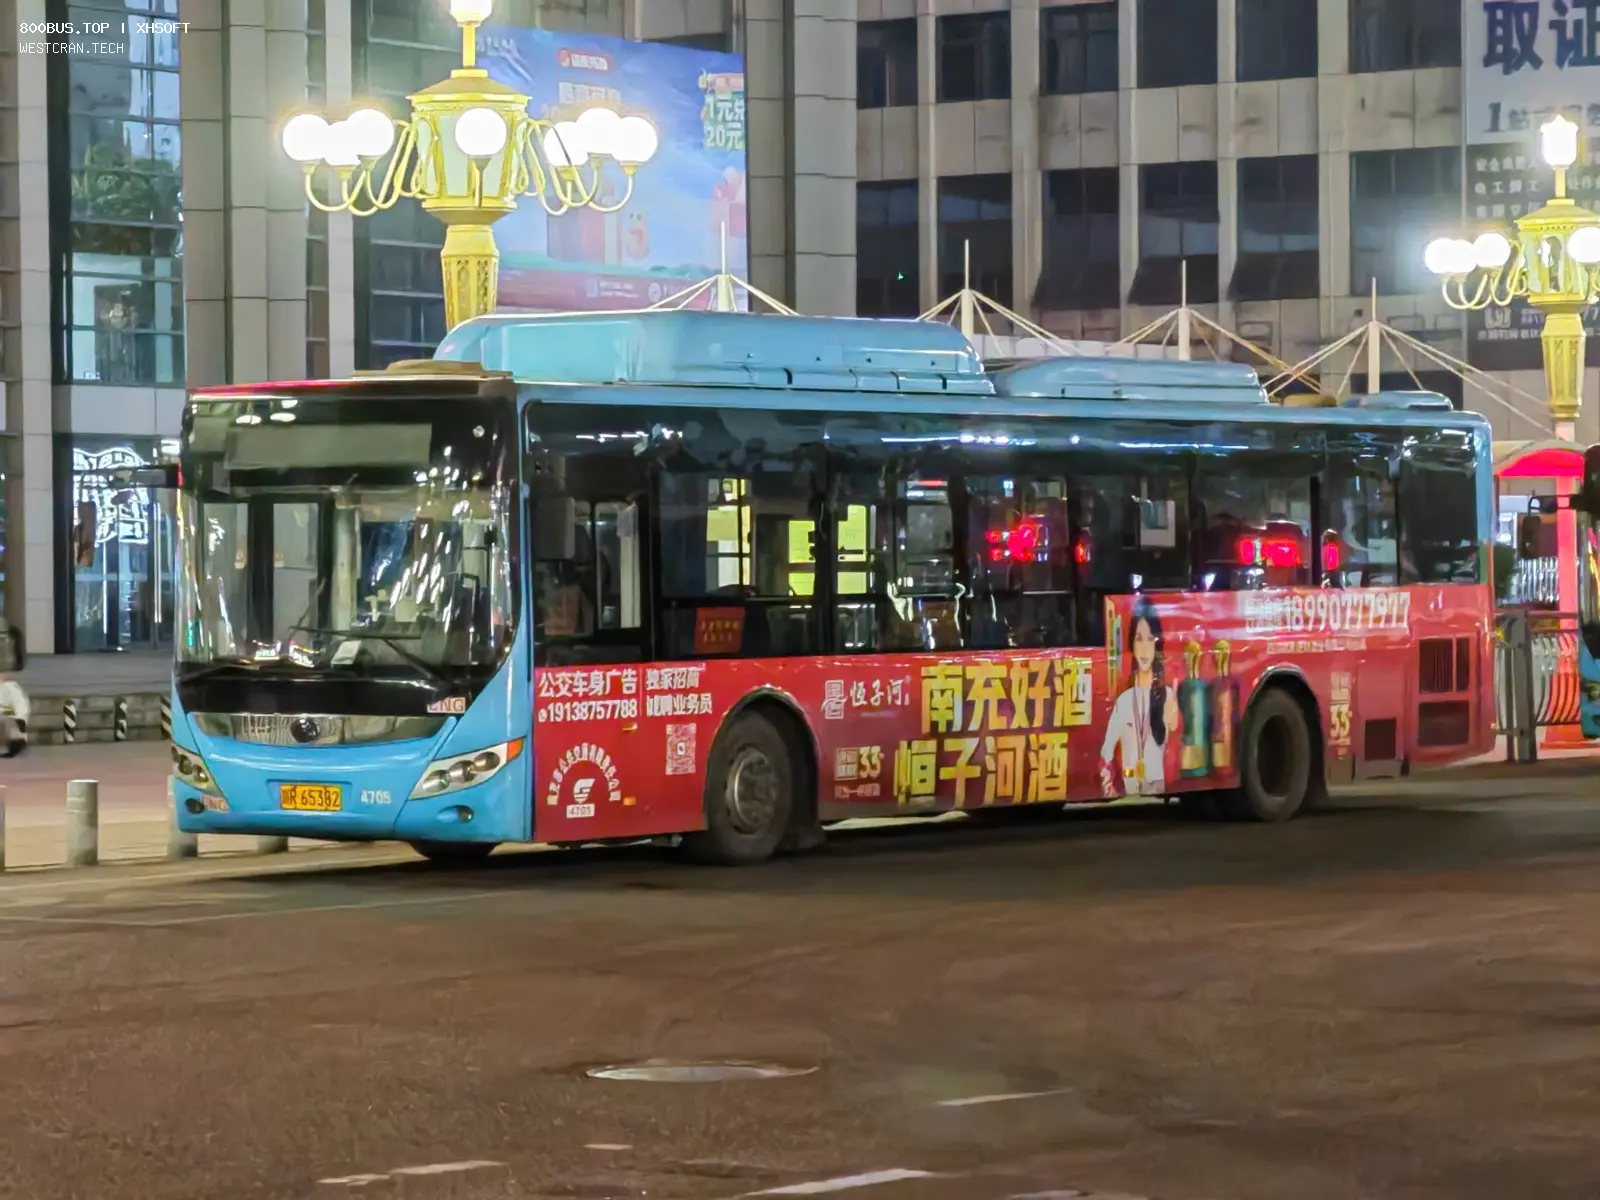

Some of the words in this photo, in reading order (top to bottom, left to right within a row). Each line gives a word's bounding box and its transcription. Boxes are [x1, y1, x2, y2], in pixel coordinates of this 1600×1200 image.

[1482, 0, 1600, 75] 取证
[539, 667, 638, 698] 公交车身广告
[547, 699, 638, 722] 19138757788
[920, 656, 1093, 735] 南充好酒
[893, 732, 1069, 809] 恒子河酒
